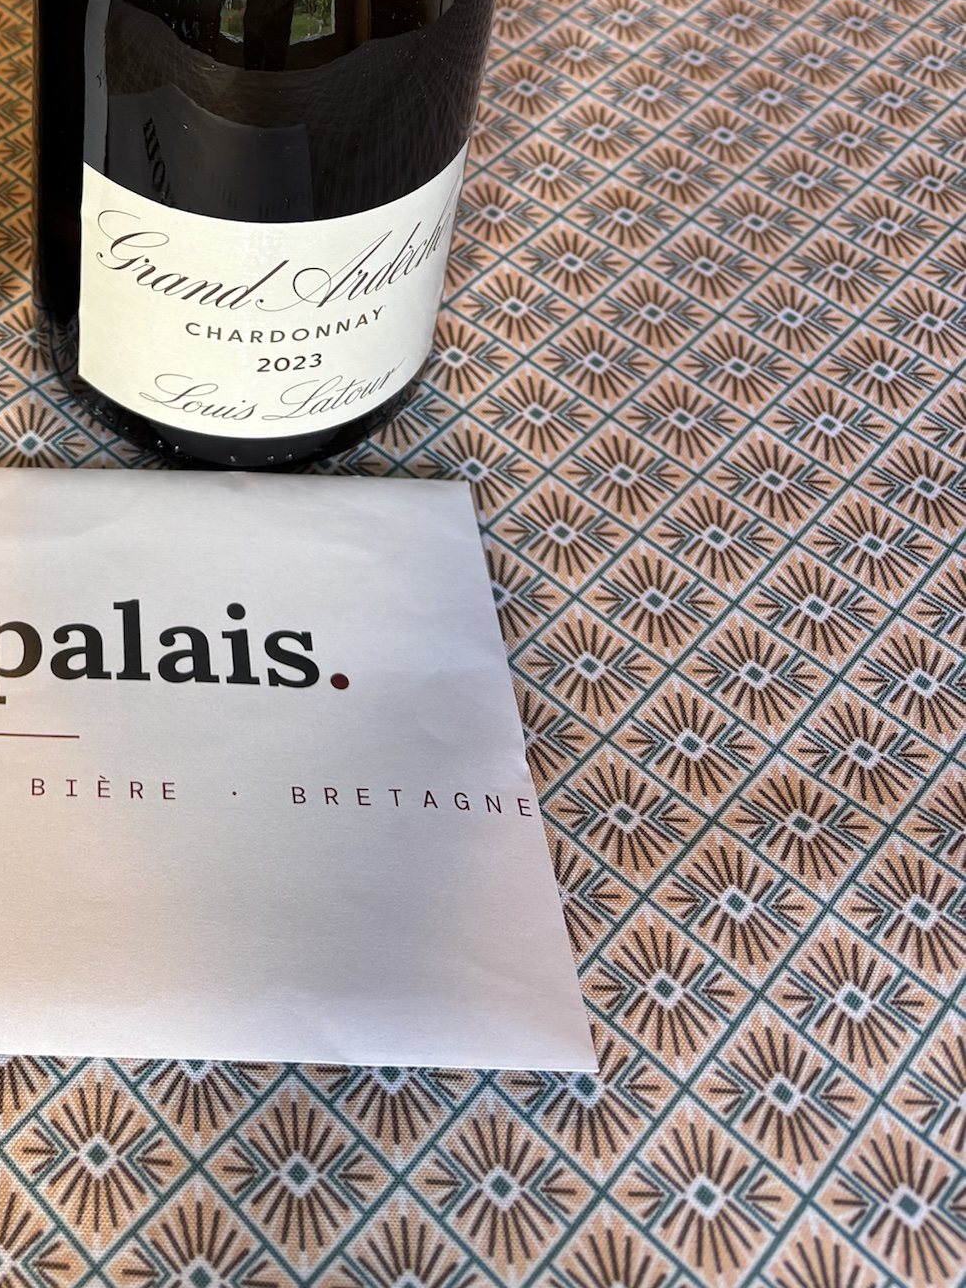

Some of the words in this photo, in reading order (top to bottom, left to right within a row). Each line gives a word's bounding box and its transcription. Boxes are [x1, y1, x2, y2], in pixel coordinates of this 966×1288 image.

[97, 210, 290, 310] Grand
[185, 306, 385, 344] CHARDONNAY
[257, 353, 323, 373] 2023
[139, 374, 259, 421] Louis
[261, 357, 406, 421] Latour
[31, 775, 177, 801] BIÈRE
[291, 786, 533, 818] BRETAGNE
